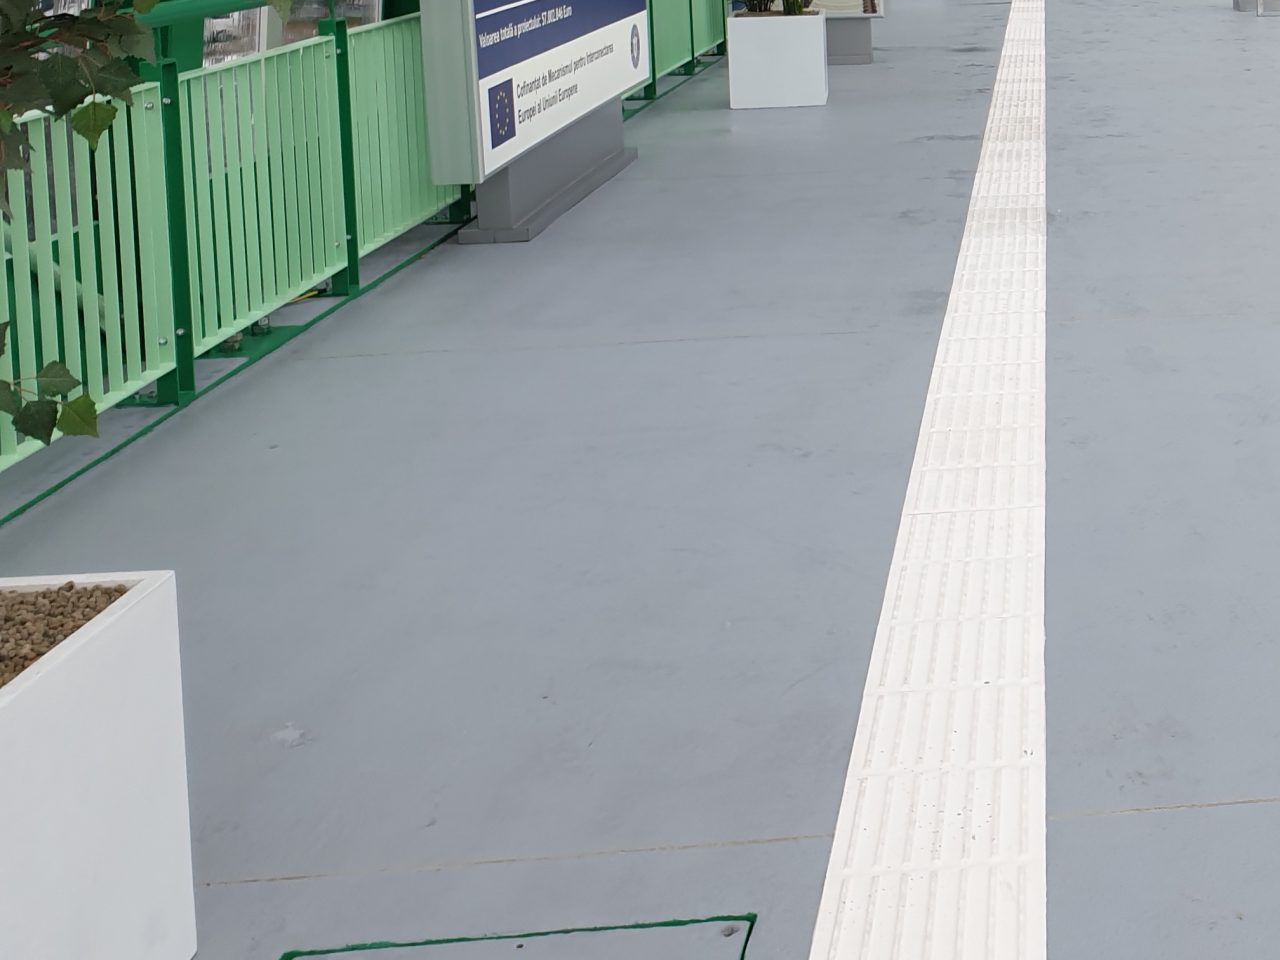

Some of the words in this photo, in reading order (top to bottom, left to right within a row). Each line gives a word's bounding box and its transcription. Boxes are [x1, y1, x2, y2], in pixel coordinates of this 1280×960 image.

[479, 32, 500, 48] Valoarea
[563, 4, 573, 18] Euro
[541, 72, 548, 87] de
[548, 59, 573, 83] Mecanismul
[573, 55, 586, 75] pentru
[517, 101, 537, 125] Europei
[537, 99, 542, 113] al
[558, 83, 578, 102] Europene
